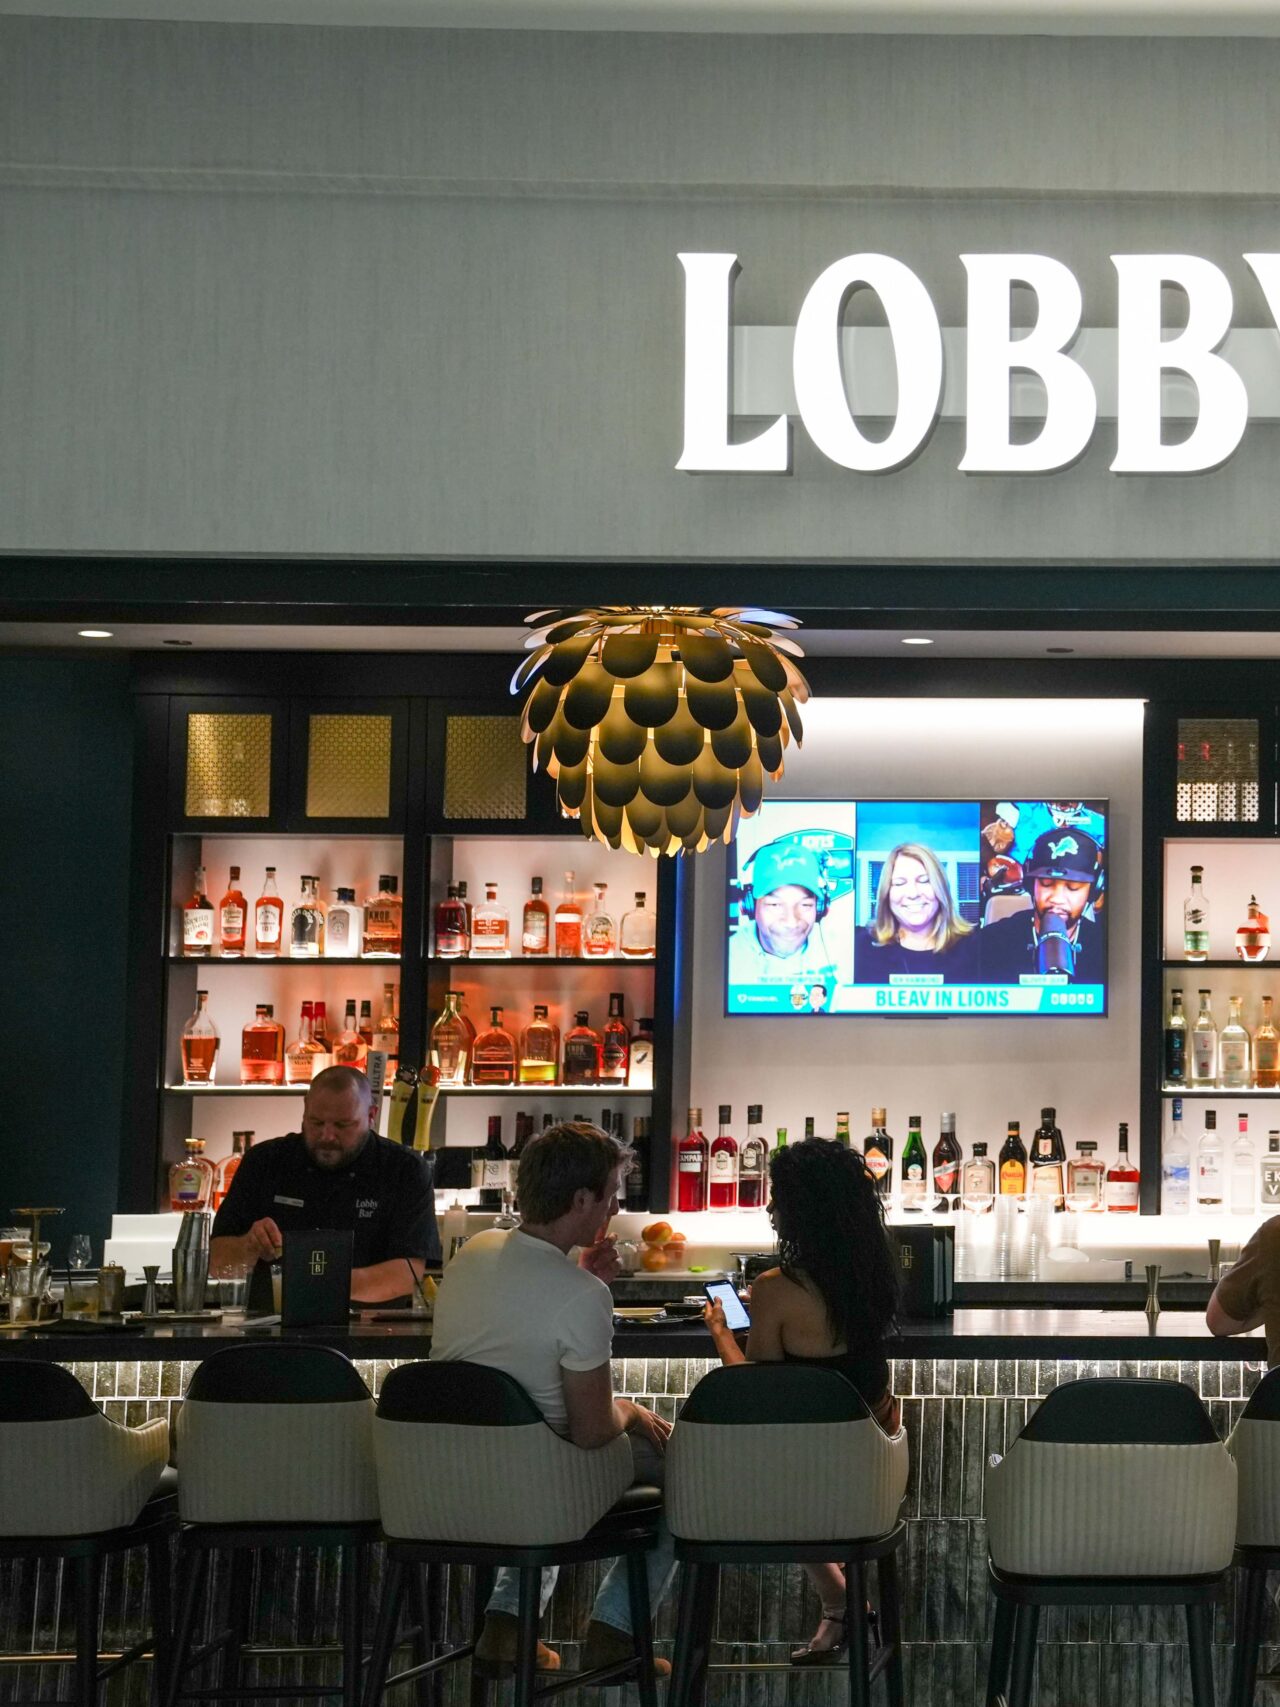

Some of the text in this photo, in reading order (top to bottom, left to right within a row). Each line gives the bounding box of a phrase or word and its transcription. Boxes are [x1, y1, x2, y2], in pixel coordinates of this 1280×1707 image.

[875, 990, 1009, 1007] BLEAV IN LIONS
[371, 1054, 383, 1090] ULTRA
[355, 1199, 379, 1211] Lobby
[358, 1208, 373, 1218] Bar
